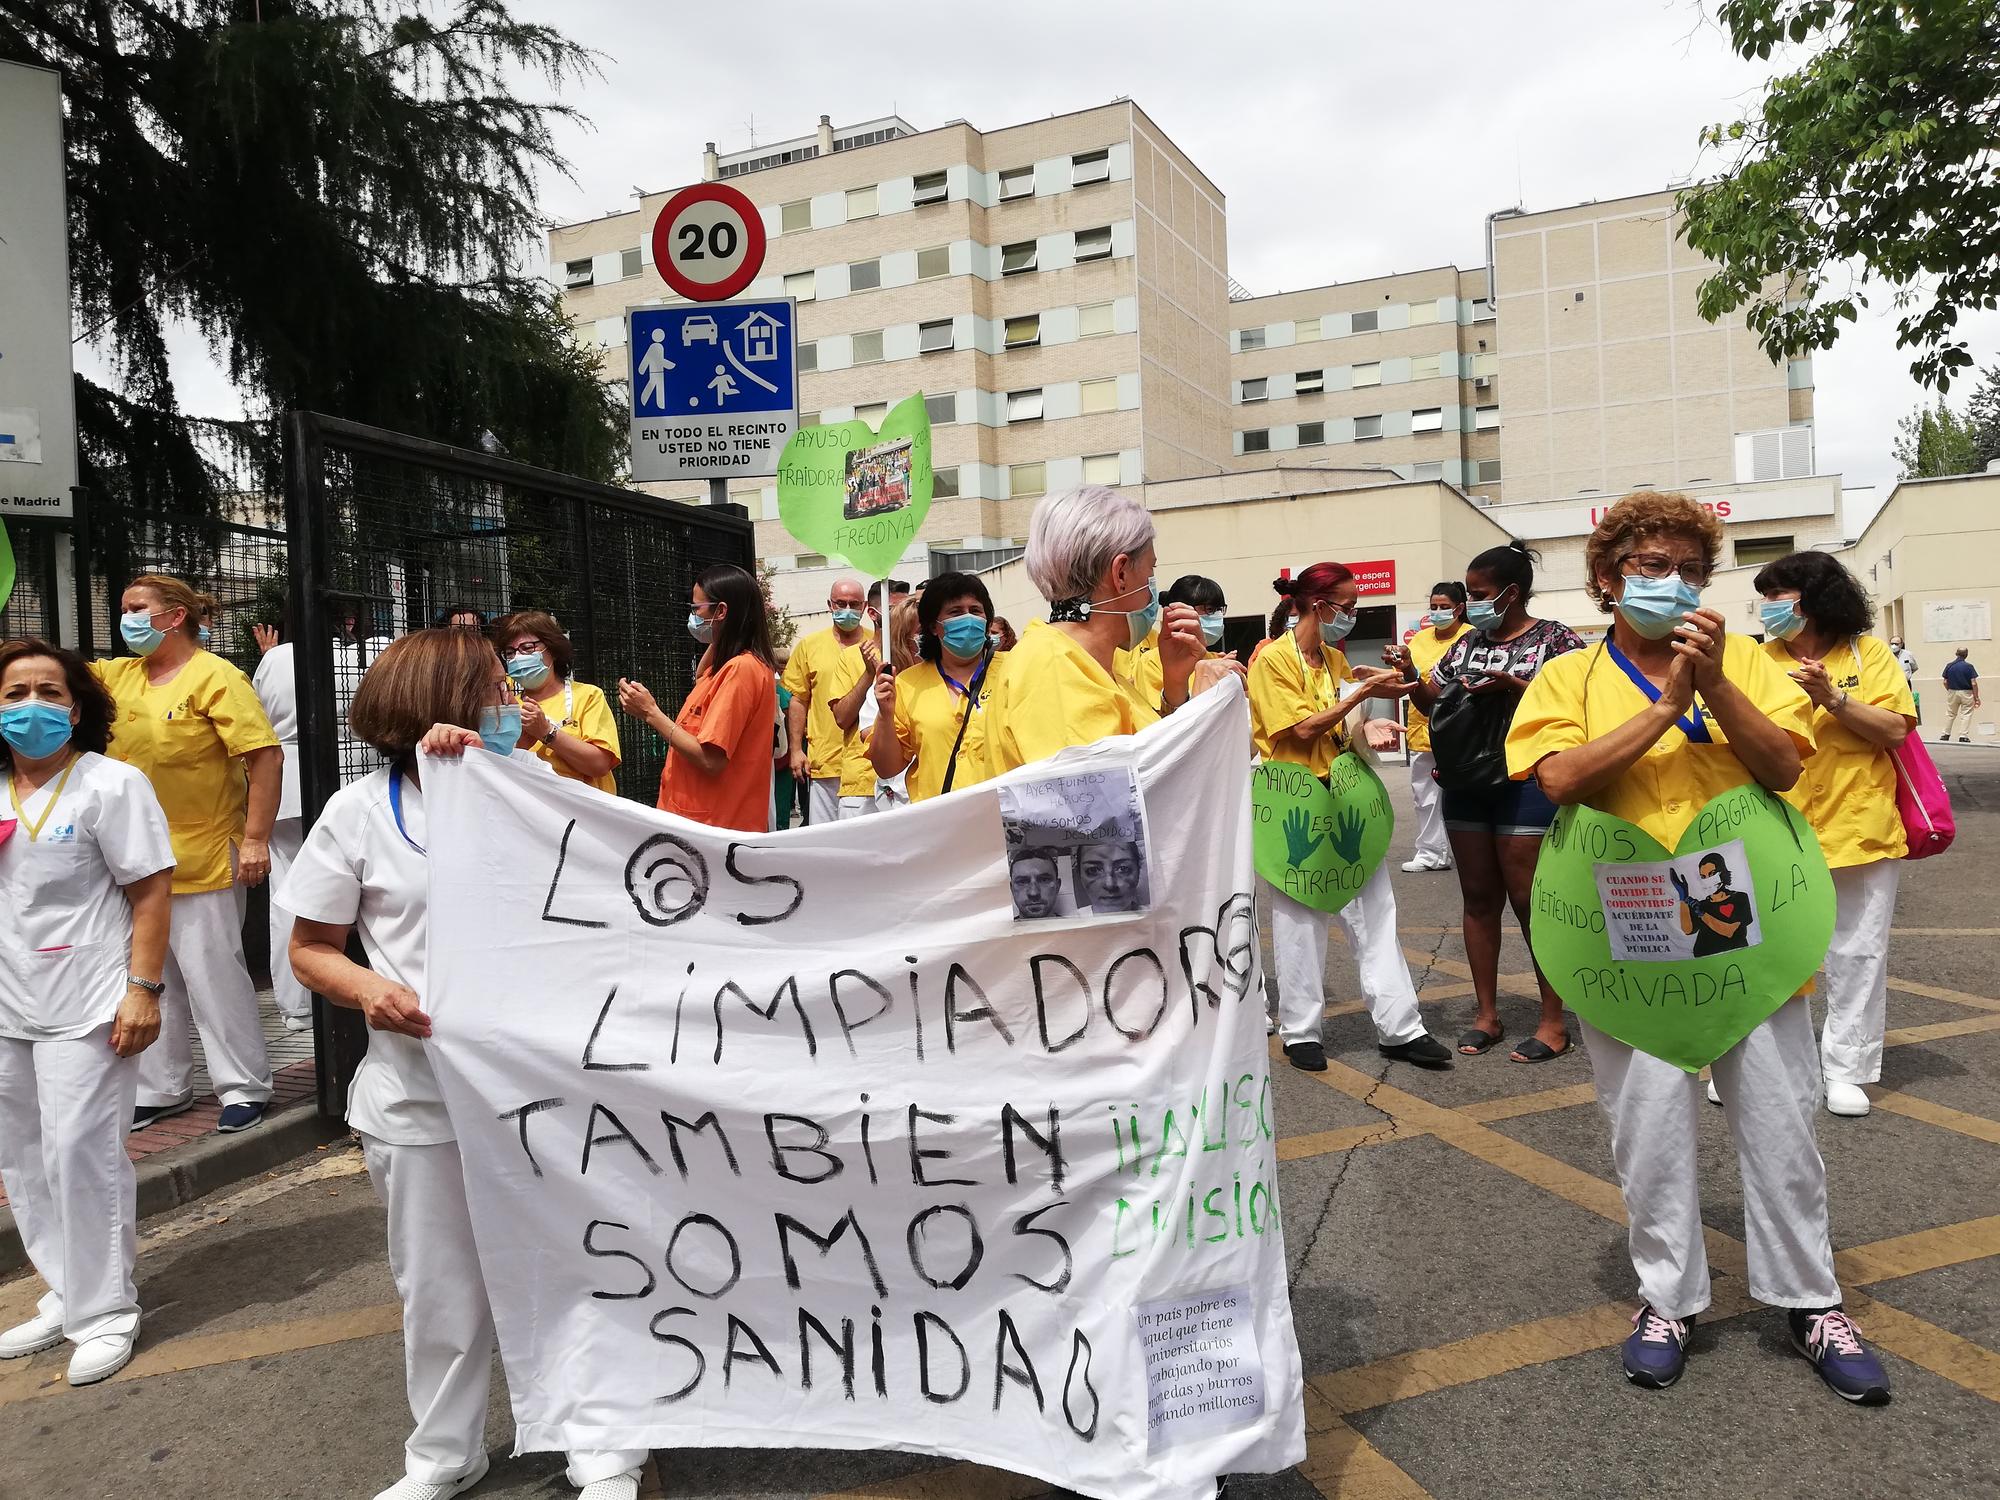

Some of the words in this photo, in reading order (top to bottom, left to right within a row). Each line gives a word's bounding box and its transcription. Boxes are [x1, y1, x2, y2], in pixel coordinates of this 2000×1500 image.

[678, 222, 737, 260] 20
[642, 430, 659, 440] EN
[665, 427, 703, 439] TODO
[708, 426, 723, 437] EL
[728, 423, 787, 436] RECINTO
[795, 428, 851, 448] AYUSO
[658, 442, 702, 454] USTED
[708, 441, 727, 452] NO
[733, 439, 771, 450] TIENE
[679, 454, 750, 467] PRIORIDAD
[13, 497, 60, 506] Madrid
[834, 513, 915, 550] FREGONA
[1362, 571, 1390, 581] espera
[1355, 581, 1391, 591] rgencias
[1025, 783, 1054, 798] AYER
[1058, 774, 1106, 791] FUIMOS
[1252, 766, 1313, 798] MANOS
[1051, 814, 1092, 829] SOMOS
[1311, 816, 1333, 832] ES
[1369, 797, 1386, 818] UN
[1063, 825, 1133, 841] DESPEDIDOS
[1573, 820, 1636, 861] NOS
[1284, 864, 1365, 895] ATRACO
[1606, 875, 1649, 885] CUANDO
[1652, 875, 1665, 884] SE
[1771, 863, 1808, 912] LA
[1611, 888, 1648, 897] OLVIDE
[1652, 887, 1665, 896] EL
[1606, 898, 1675, 909] CORONVIRUS
[1612, 910, 1674, 920] ACUÉRDATE
[1629, 923, 1644, 931] DE
[1646, 923, 1659, 931] LA
[1623, 934, 1669, 942] SANIDAD
[1626, 943, 1671, 953] PÚBLICA
[583, 1201, 1073, 1299] SOMOS
[1138, 1313, 1152, 1328] Un
[1156, 1306, 1182, 1326] país
[1185, 1299, 1220, 1319] pobre
[1223, 1297, 1237, 1308] es
[1143, 1327, 1173, 1347] aquel
[1175, 1324, 1197, 1341] que
[1200, 1317, 1233, 1332] tiene
[1147, 1336, 1233, 1366] universitarios
[1216, 1356, 1240, 1373] por
[1196, 1383, 1205, 1398] y
[1208, 1374, 1253, 1391] burros
[1198, 1393, 1258, 1414] millones.
